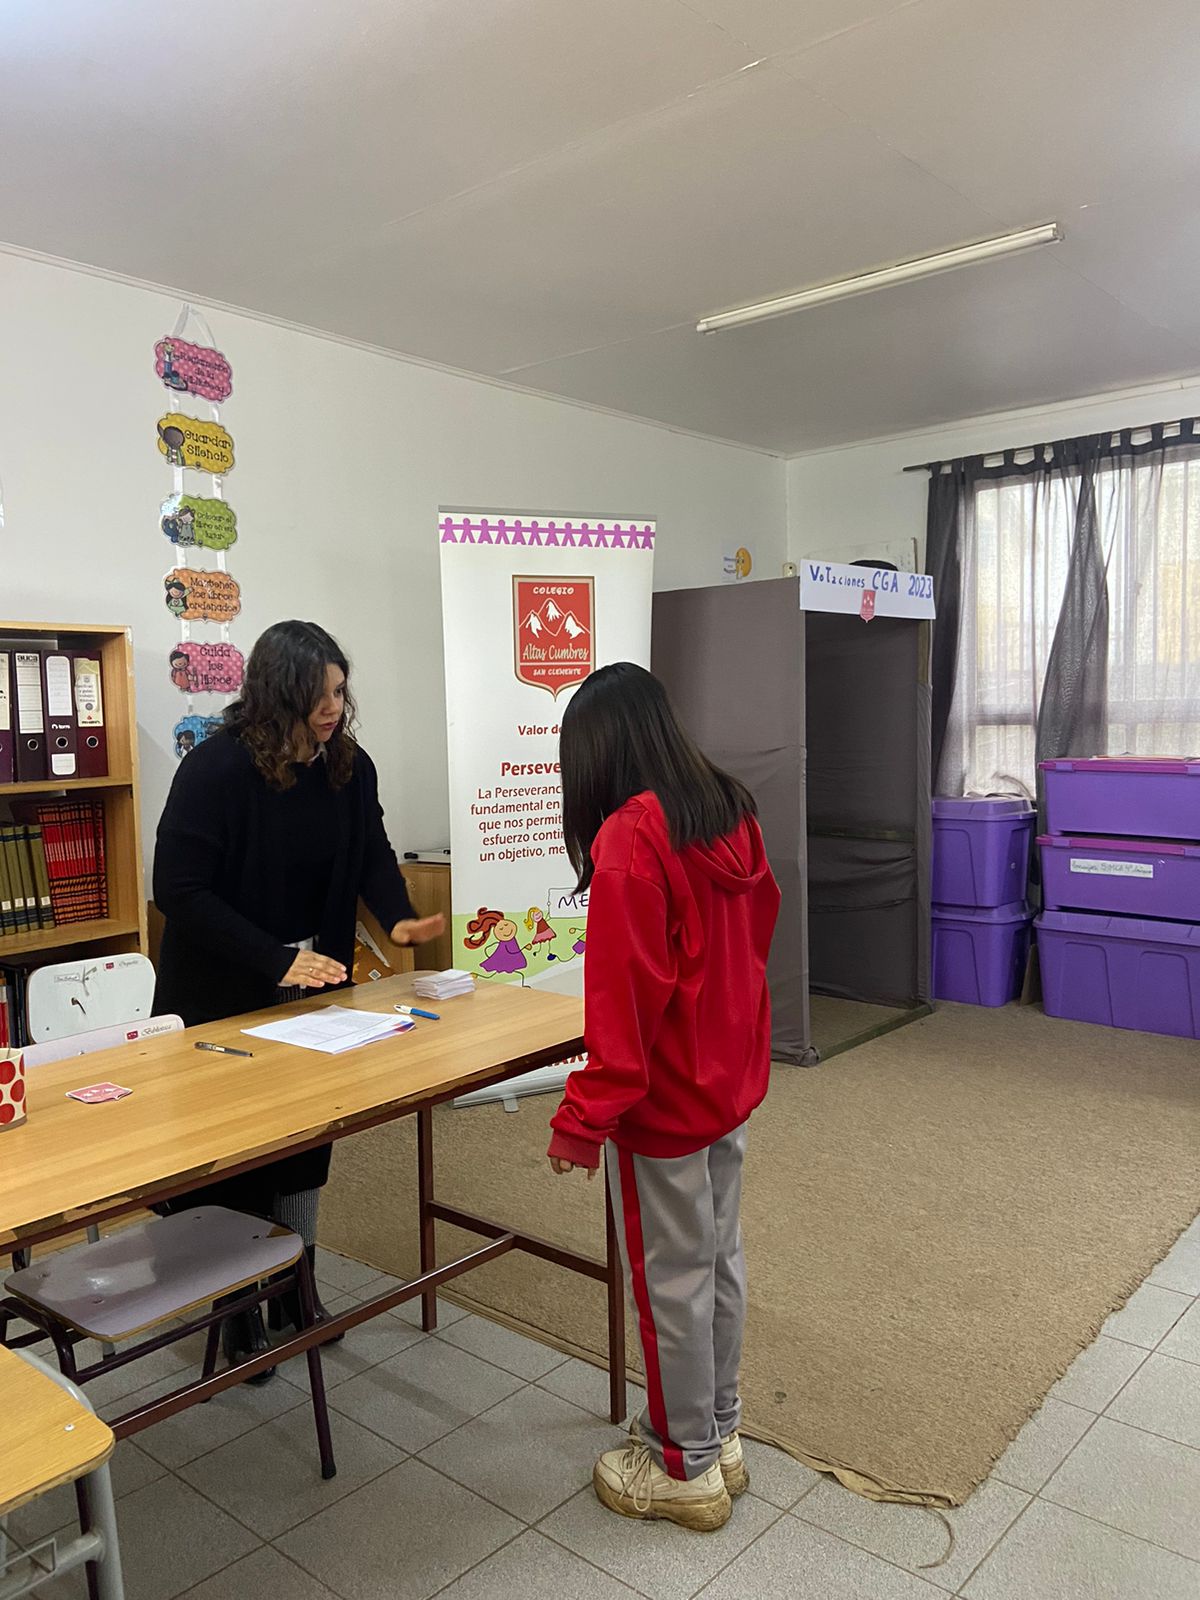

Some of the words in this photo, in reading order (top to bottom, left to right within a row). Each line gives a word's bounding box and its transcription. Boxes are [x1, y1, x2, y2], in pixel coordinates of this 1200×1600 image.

[184, 429, 231, 449] Guardar
[532, 586, 575, 596] COLEGIO
[872, 570, 899, 593] CGA
[908, 574, 933, 599] 2023
[523, 643, 547, 660] Altas
[549, 643, 589, 660] Cumbres
[532, 668, 546, 676] SAN
[547, 667, 581, 676] CLEMENTE
[517, 724, 549, 736] Valor
[551, 723, 562, 735] d
[501, 761, 562, 777] Perseve
[478, 788, 492, 799] La
[495, 785, 561, 798] Perseveranc
[470, 800, 544, 815] fundamental
[546, 800, 560, 810] en
[478, 820, 501, 833] que
[503, 818, 524, 828] nos
[526, 813, 562, 830] permit
[482, 833, 530, 846] esfuerzo
[479, 852, 495, 862] un
[498, 846, 546, 862] objetivo,
[548, 845, 566, 855] me
[558, 894, 589, 910] ME
